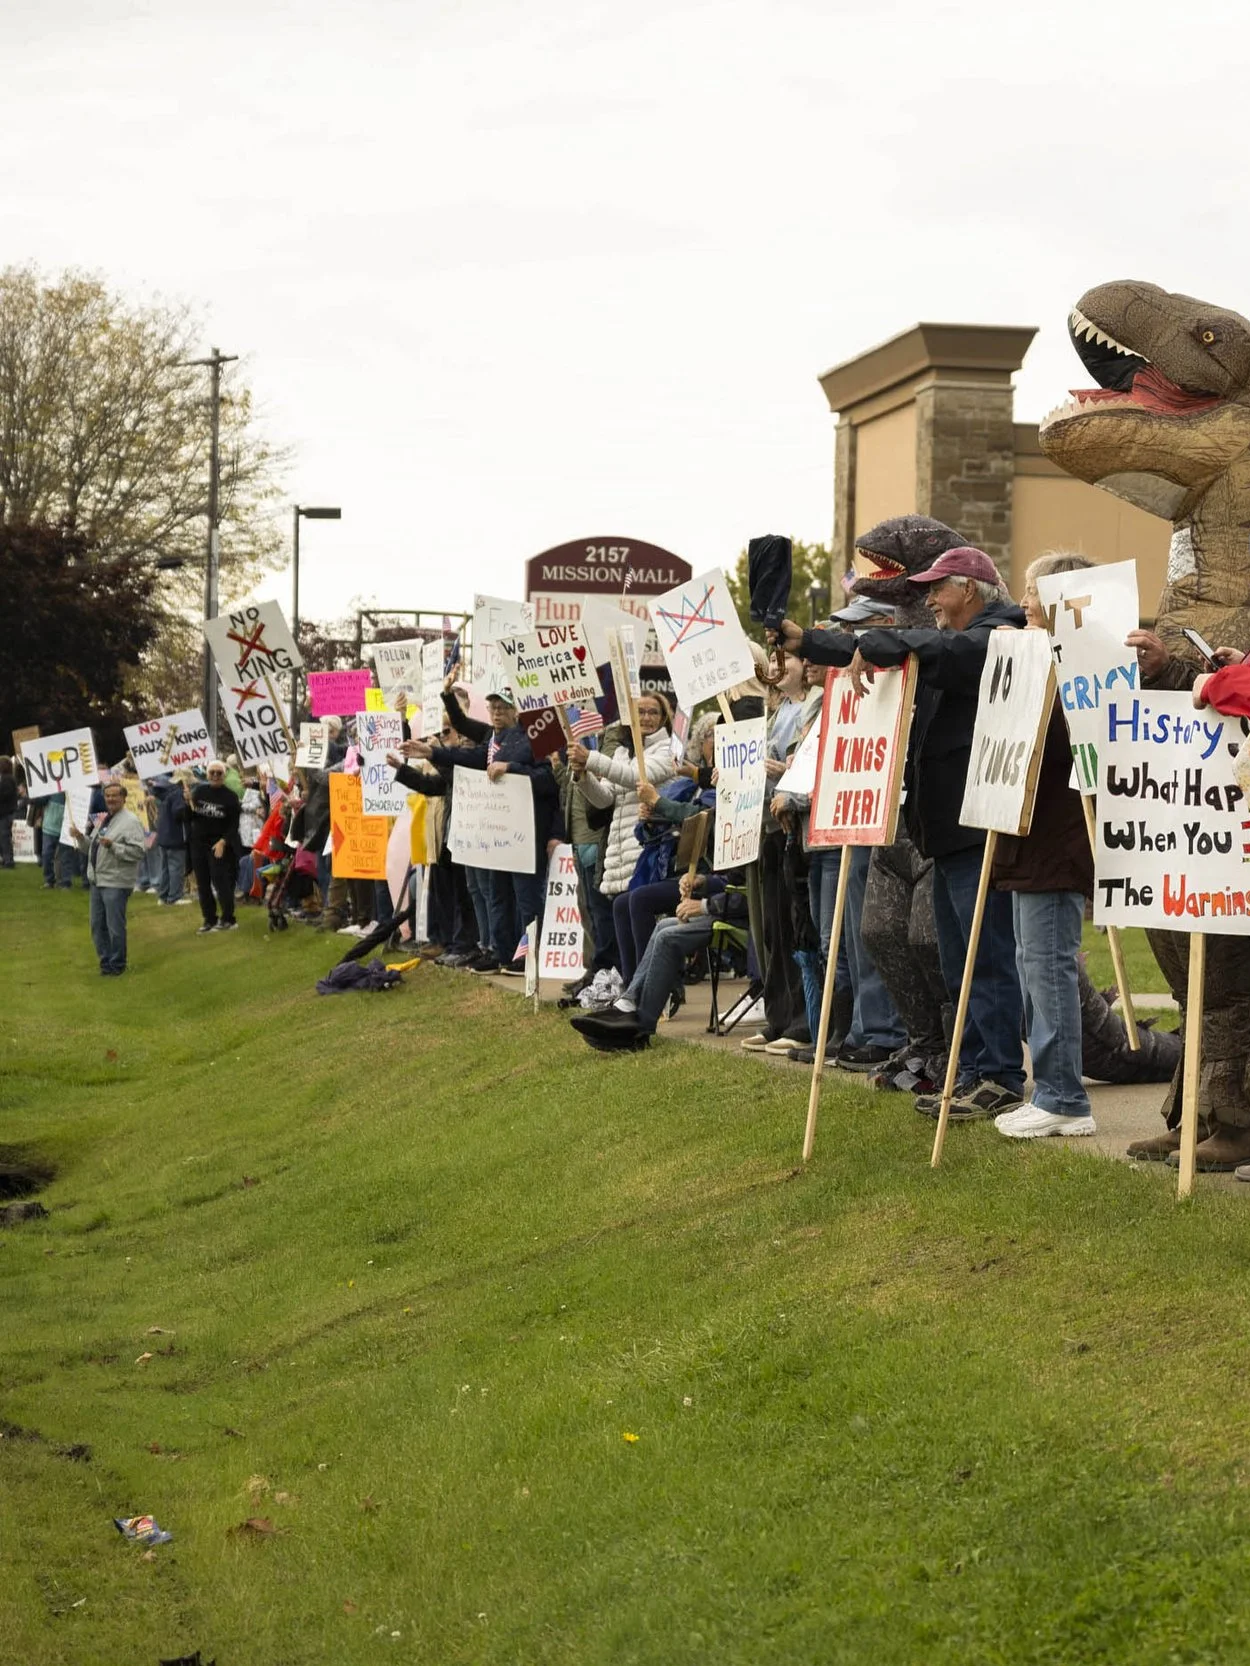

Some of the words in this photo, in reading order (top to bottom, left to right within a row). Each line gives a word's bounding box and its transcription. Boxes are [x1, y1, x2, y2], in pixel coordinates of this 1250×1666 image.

[585, 546, 630, 563] 2157
[541, 565, 624, 581] MISSION
[631, 567, 681, 585] MALL
[229, 606, 260, 629] NO
[500, 639, 525, 657] We
[537, 624, 579, 649] LOVE
[234, 648, 293, 683] KING
[379, 648, 411, 662] FOLLOW
[517, 650, 572, 672] America
[550, 662, 588, 685] HATE
[989, 654, 1013, 704] NO
[518, 694, 550, 712] What
[569, 685, 596, 703] doing
[837, 690, 861, 725] NO
[138, 720, 161, 736] NO
[234, 704, 277, 732] NO
[527, 708, 556, 741] GOD
[1109, 698, 1225, 761] History
[131, 738, 167, 759] FAUX
[174, 727, 208, 746] KING
[170, 745, 208, 767] WAAY
[308, 726, 325, 765] NOPE
[833, 736, 888, 774] KINGS
[362, 763, 390, 785] VOTE
[1106, 761, 1179, 805] What
[1184, 767, 1250, 813] Hap
[364, 797, 405, 813] DEMOCRACY
[1103, 820, 1177, 853] When
[1183, 821, 1233, 856] You
[548, 880, 563, 897] IS
[1098, 876, 1154, 908] The
